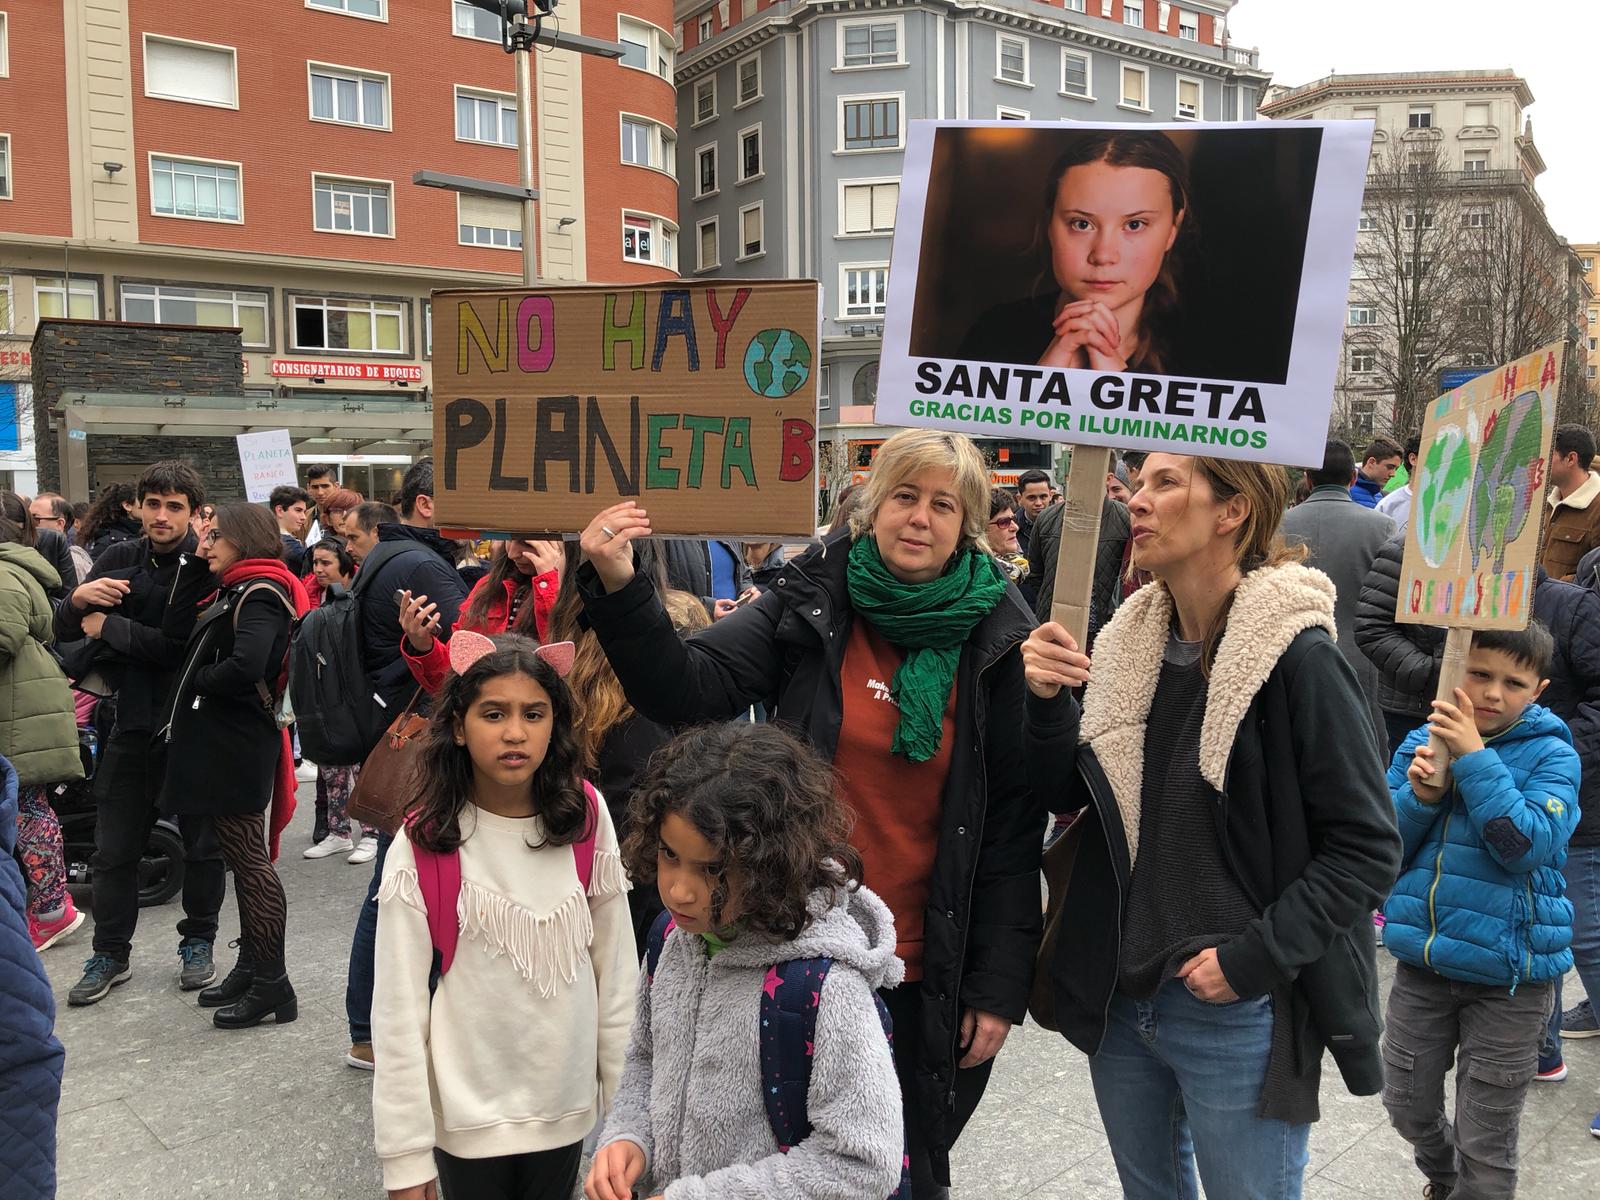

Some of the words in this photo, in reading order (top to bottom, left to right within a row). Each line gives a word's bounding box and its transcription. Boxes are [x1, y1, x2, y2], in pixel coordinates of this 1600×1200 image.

[457, 295, 555, 374] NO
[602, 288, 752, 373] HAY
[272, 362, 362, 377] CONSIGNATARIOS
[366, 365, 379, 377] DE
[383, 366, 421, 379] BUQUES
[914, 361, 1072, 406] SANTA
[1089, 375, 1267, 423] GRETA
[909, 399, 1012, 425] GRACIAS
[1020, 409, 1070, 430] POR
[1079, 414, 1268, 449] ILUMINARNOS
[243, 448, 291, 462] PLANETA
[444, 395, 759, 496] PLANETA
[254, 470, 284, 481] BANCO
[873, 690, 881, 700] A
